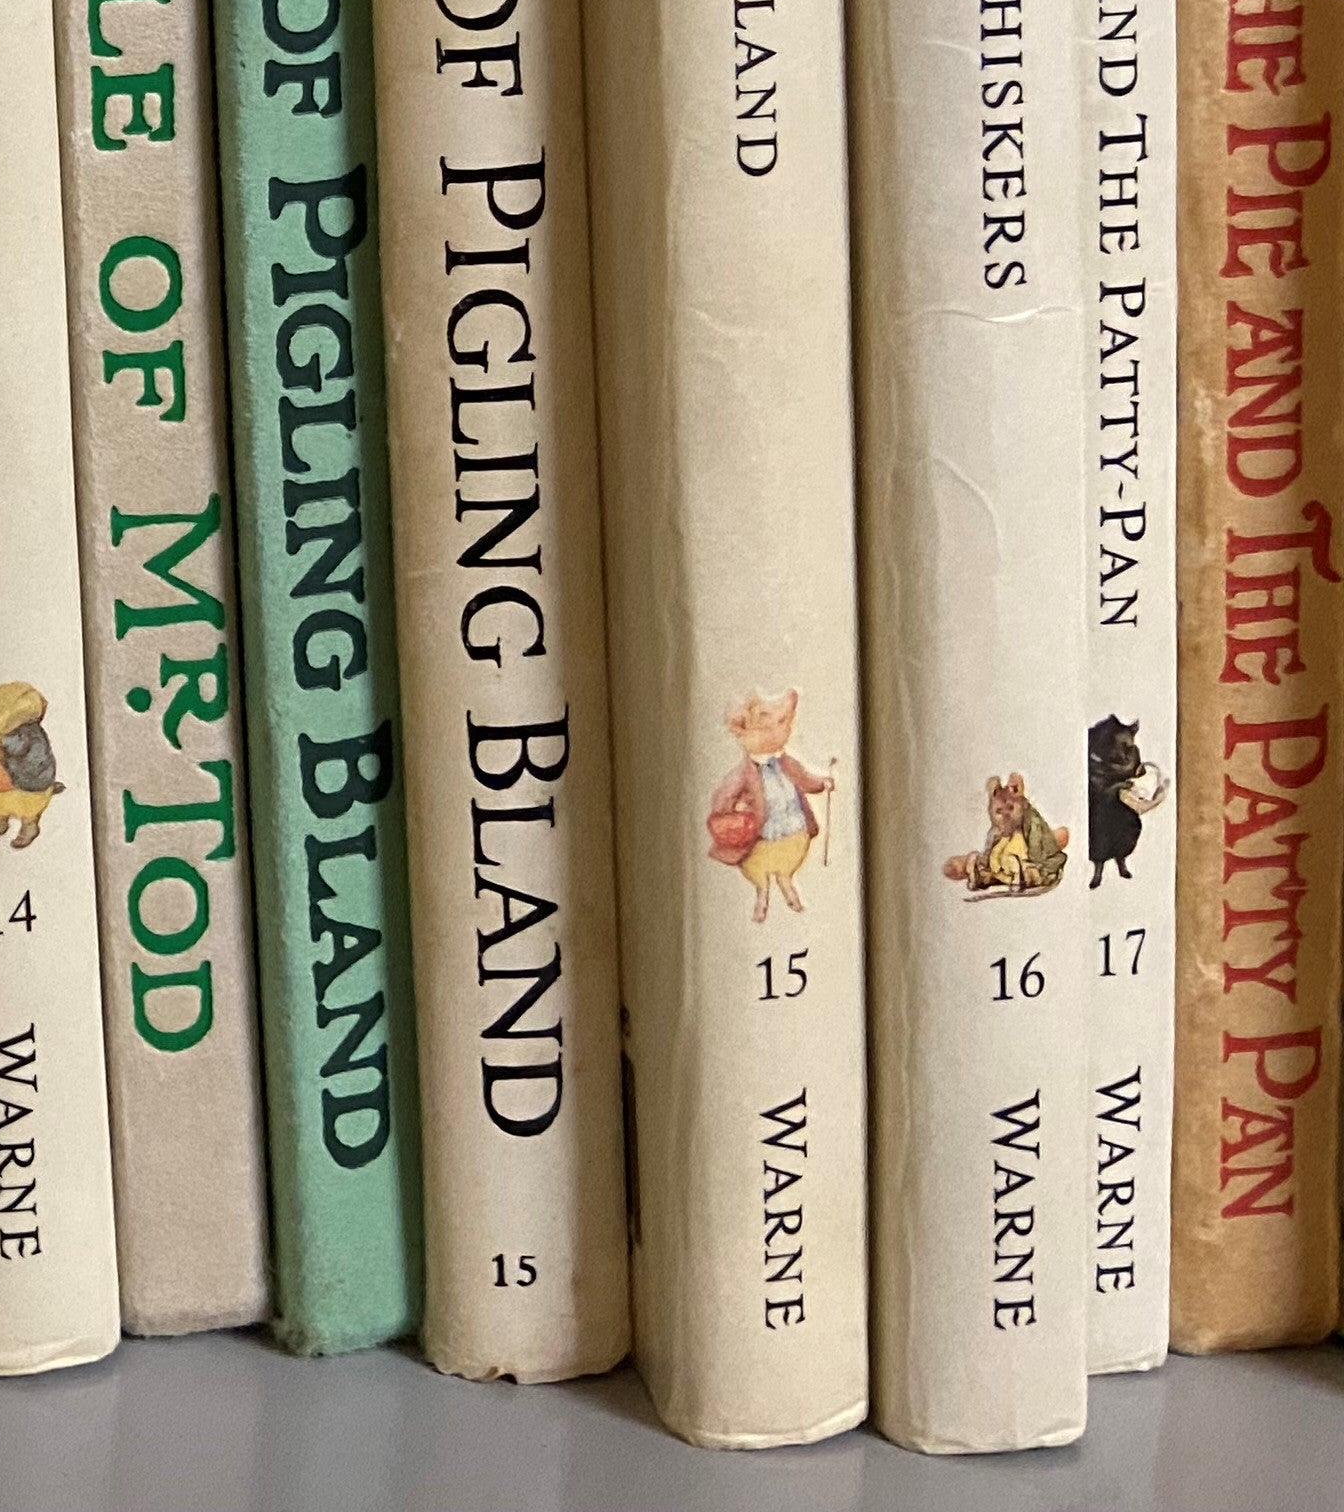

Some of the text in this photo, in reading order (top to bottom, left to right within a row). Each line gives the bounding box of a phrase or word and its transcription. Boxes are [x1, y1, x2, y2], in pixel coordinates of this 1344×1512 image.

[1098, 114, 1149, 257] THE
[1219, 113, 1332, 281] PIE
[99, 235, 186, 423] OF
[267, 163, 367, 692] PIGLING
[441, 145, 546, 668] PIGLING
[1226, 302, 1306, 497] AND
[1100, 282, 1147, 628] PATTY-PAN
[1218, 500, 1344, 686] THE
[299, 717, 393, 1170] BLAND
[465, 704, 570, 1137] BLAND
[1222, 703, 1330, 1004] PATTY
[757, 950, 808, 1001] 15
[989, 952, 1046, 1001] 16
[1097, 929, 1145, 977] 17
[760, 1087, 806, 1329] WARNE
[991, 1087, 1040, 1332] WARNE
[1096, 1065, 1141, 1294] WARNE
[1218, 1024, 1322, 1222] PAN
[491, 1256, 538, 1288] 15
